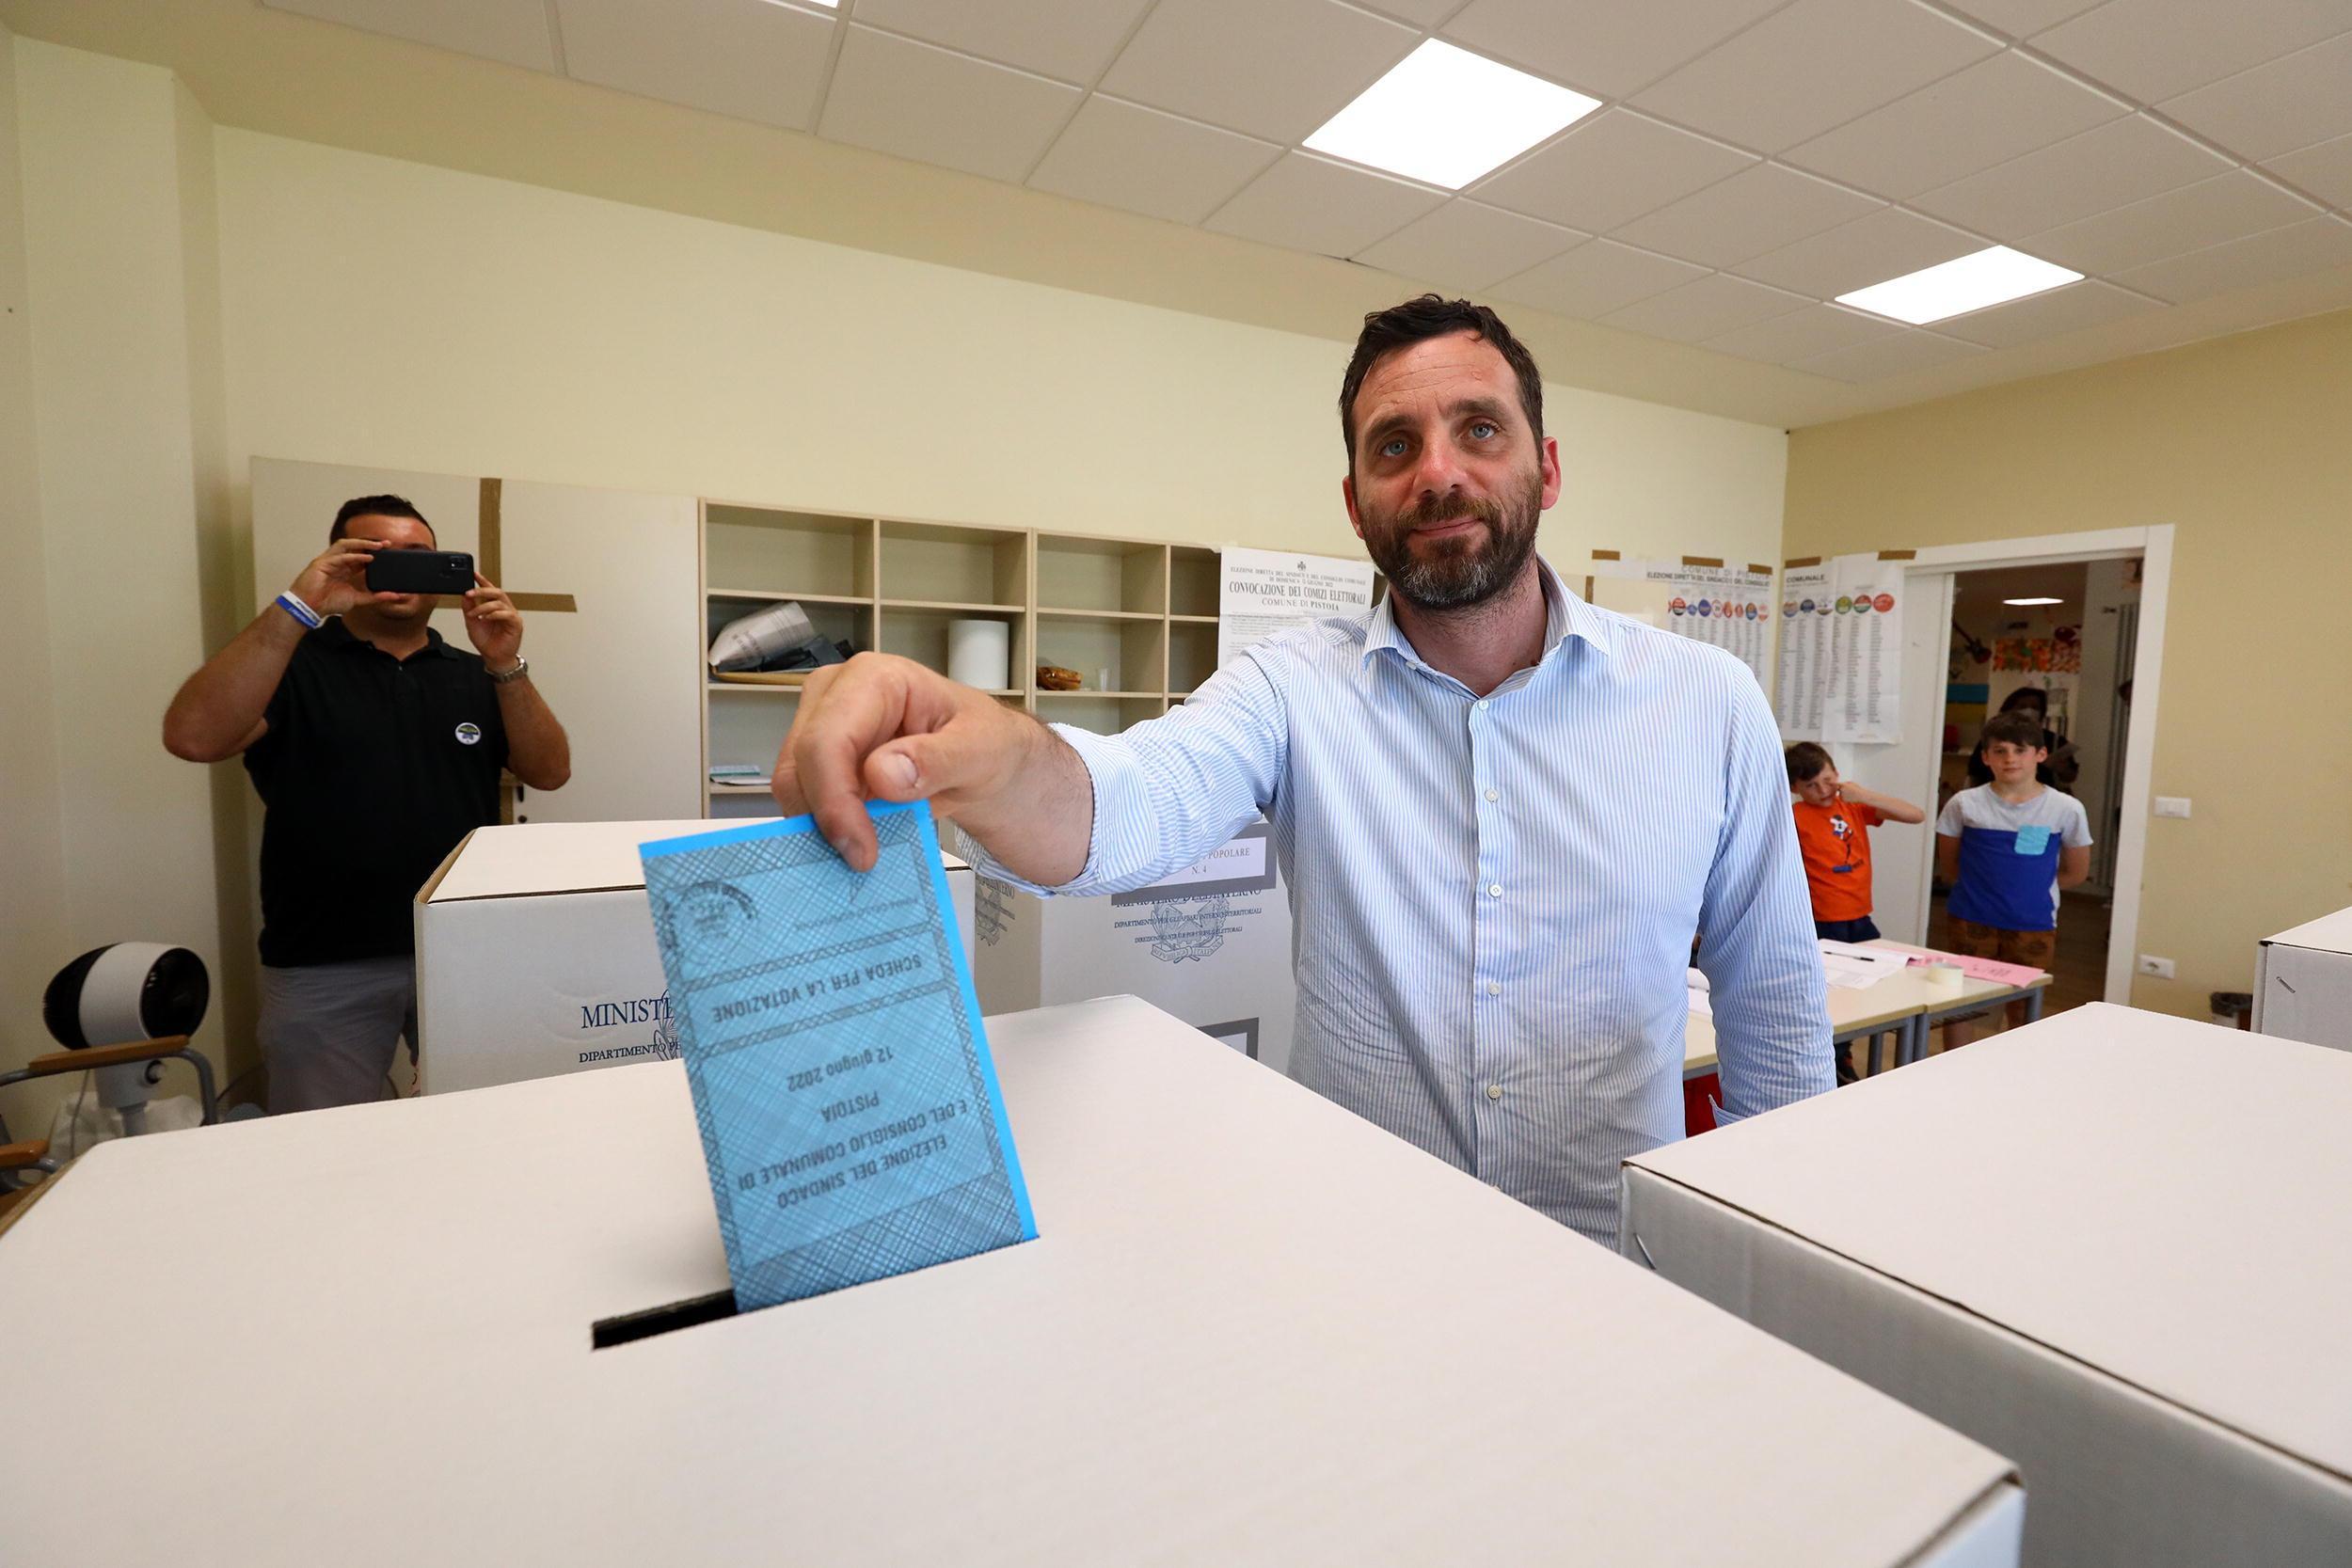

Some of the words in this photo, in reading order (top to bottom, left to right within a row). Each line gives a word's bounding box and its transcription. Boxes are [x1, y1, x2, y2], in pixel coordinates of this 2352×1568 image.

[1229, 580, 1285, 596] CONVOCAZIONE
[1288, 585, 1301, 597] DEI
[1303, 586, 1327, 600] COMIZI
[1329, 589, 1366, 605] ELETTORALI
[1261, 596, 1297, 607] COMUNE
[1300, 599, 1309, 608] DI
[1311, 600, 1339, 611] PISTOIA
[1208, 847, 1250, 860] POPOLARE
[1191, 866, 1200, 875] N.
[866, 954, 922, 981] SCHEDA
[806, 979, 826, 997] LA
[832, 972, 860, 991] PER
[711, 987, 802, 1023] VOTAZIONE
[580, 1042, 666, 1063] DIPARTIMENTO
[827, 1048, 873, 1076] giugno
[877, 1046, 894, 1064] 12
[786, 1068, 824, 1092] 2022
[819, 1090, 880, 1123] PISTOIA
[929, 1101, 956, 1124] DEL
[959, 1099, 968, 1115] E
[849, 1114, 928, 1153] CONSIGLIO
[760, 1141, 846, 1183] COMUNALE
[882, 1133, 947, 1171] ELEZIONE
[738, 1171, 756, 1192] DI
[851, 1160, 878, 1181] DEL
[777, 1171, 847, 1209] SINDACO
